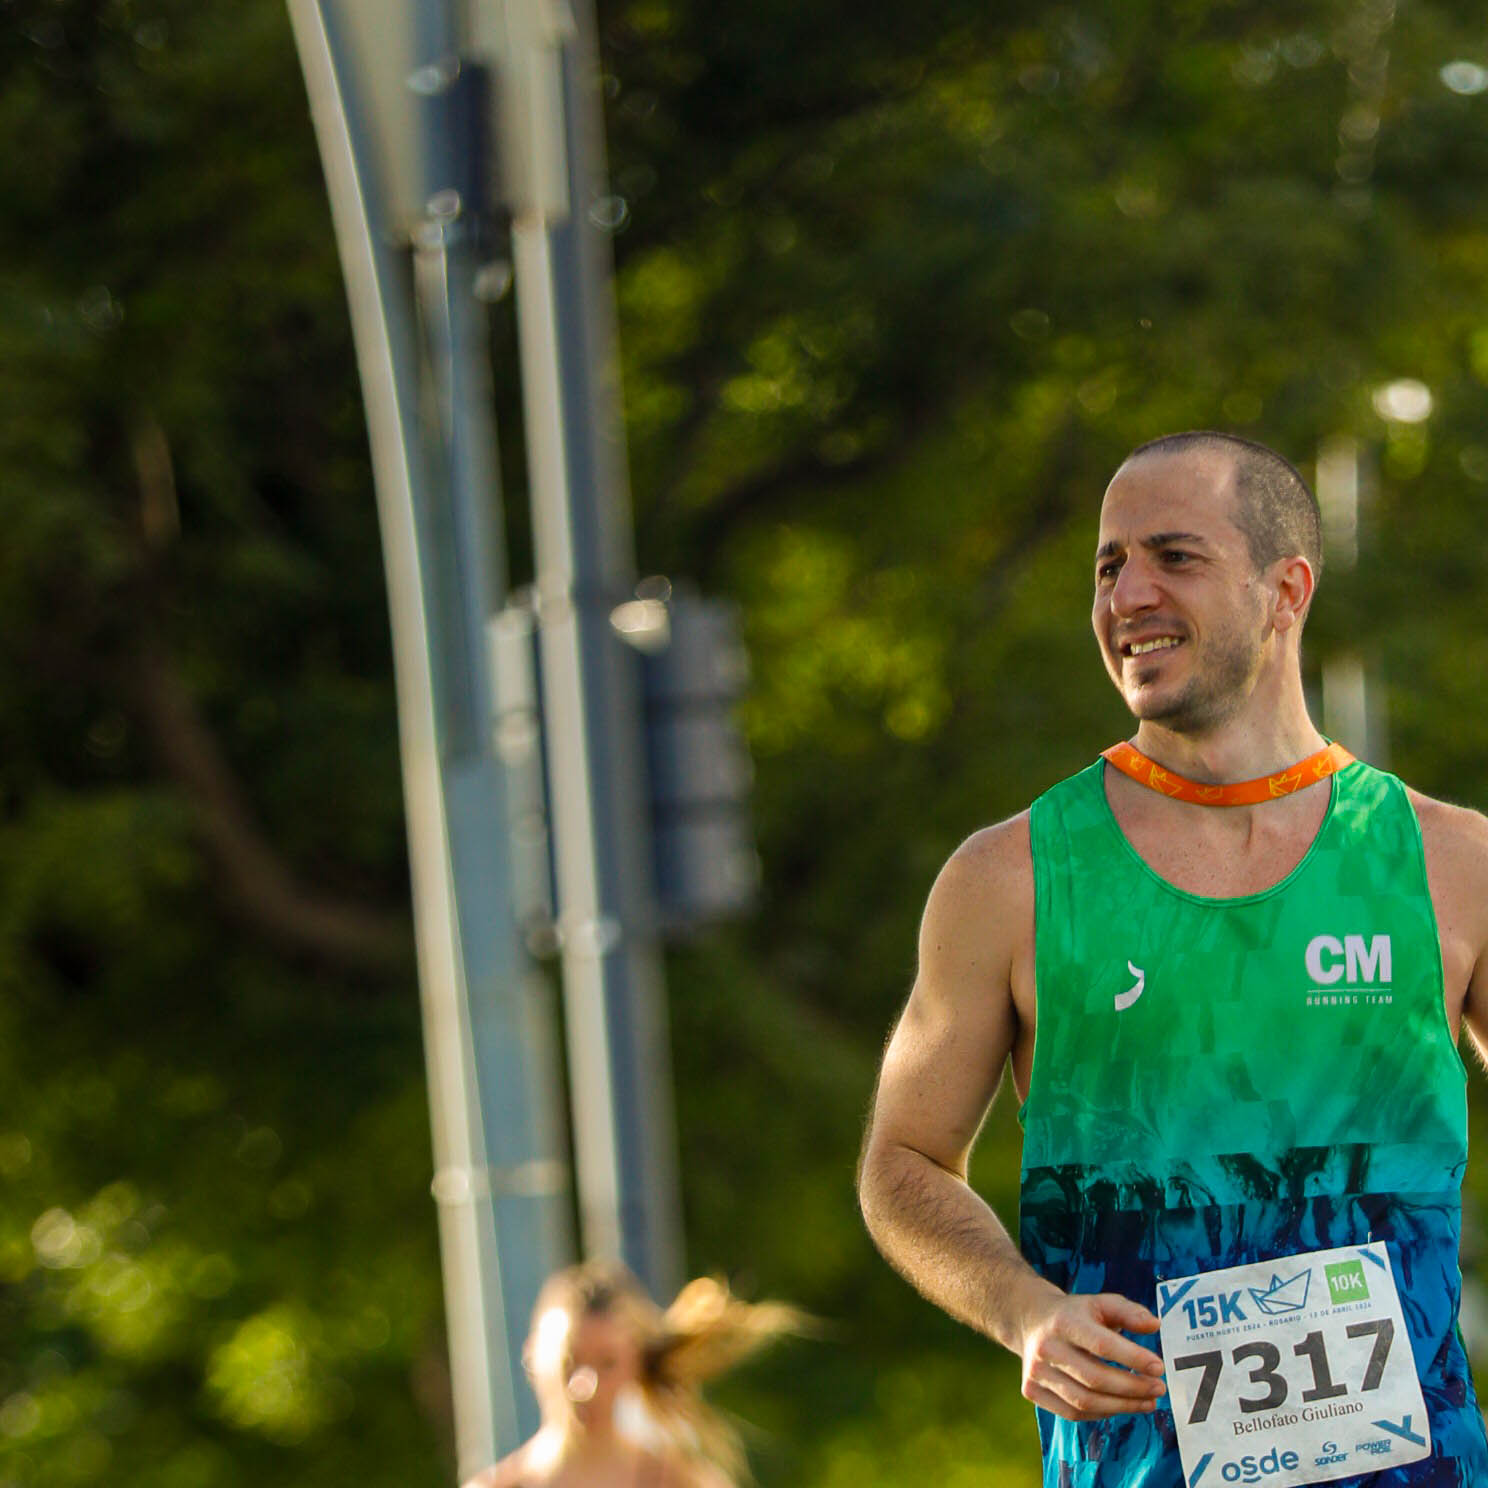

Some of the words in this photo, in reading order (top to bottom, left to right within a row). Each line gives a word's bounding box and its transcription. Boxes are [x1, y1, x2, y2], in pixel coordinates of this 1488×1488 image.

[1305, 934, 1392, 985] CM
[1306, 995, 1358, 1006] RUNNING
[1365, 994, 1393, 1005] TEAM
[1330, 1272, 1363, 1292] 10K
[1182, 1289, 1249, 1330] 15K
[1174, 1318, 1395, 1424] 7317
[1232, 1413, 1299, 1436] Bellofato
[1302, 1401, 1364, 1423] Giuliano
[1221, 1447, 1299, 1482] osde
